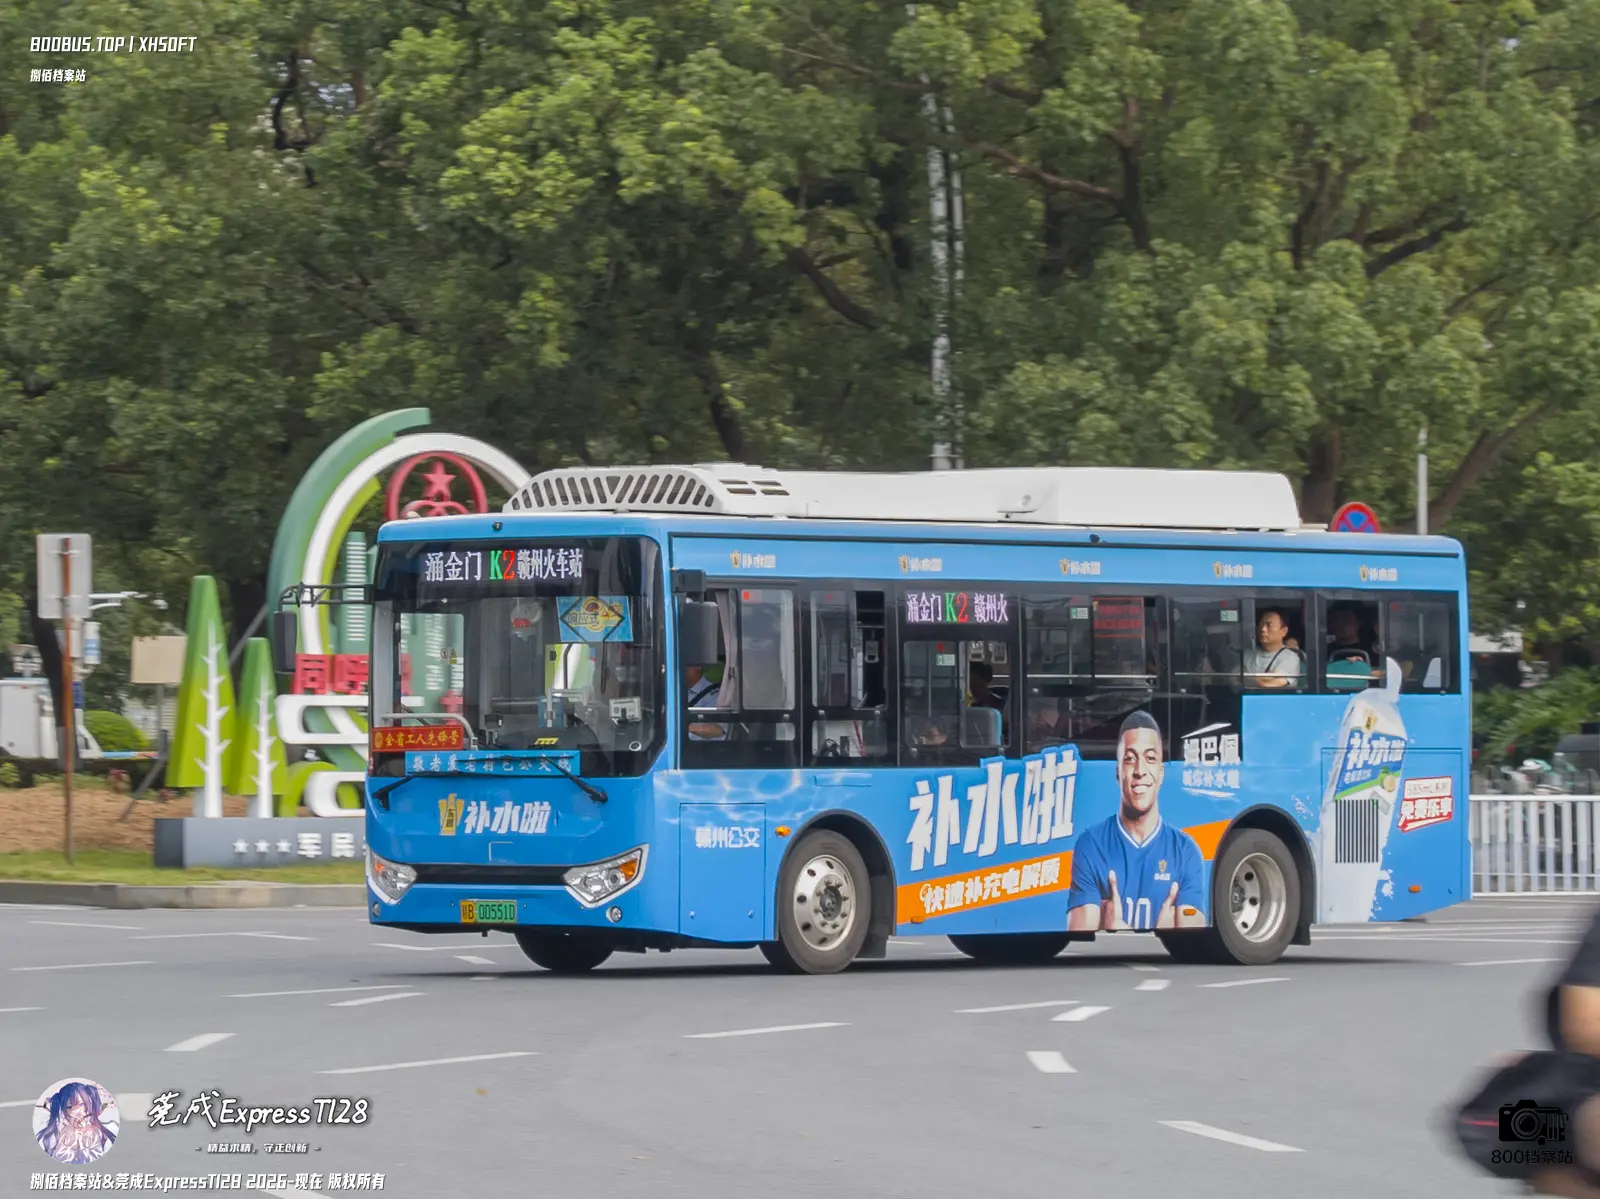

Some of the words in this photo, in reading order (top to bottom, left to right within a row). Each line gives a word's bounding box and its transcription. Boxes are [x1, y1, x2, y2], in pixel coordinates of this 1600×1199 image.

[425, 551, 483, 582] 涌金门
[489, 550, 515, 581] K2
[517, 548, 583, 580] 赣州火车站
[907, 592, 942, 623] 涌金门
[944, 592, 969, 623] K2
[974, 592, 1009, 623] 赣州火
[464, 801, 551, 834] 补水啦
[906, 749, 1078, 872] 补水啦
[298, 832, 367, 858] 军民
